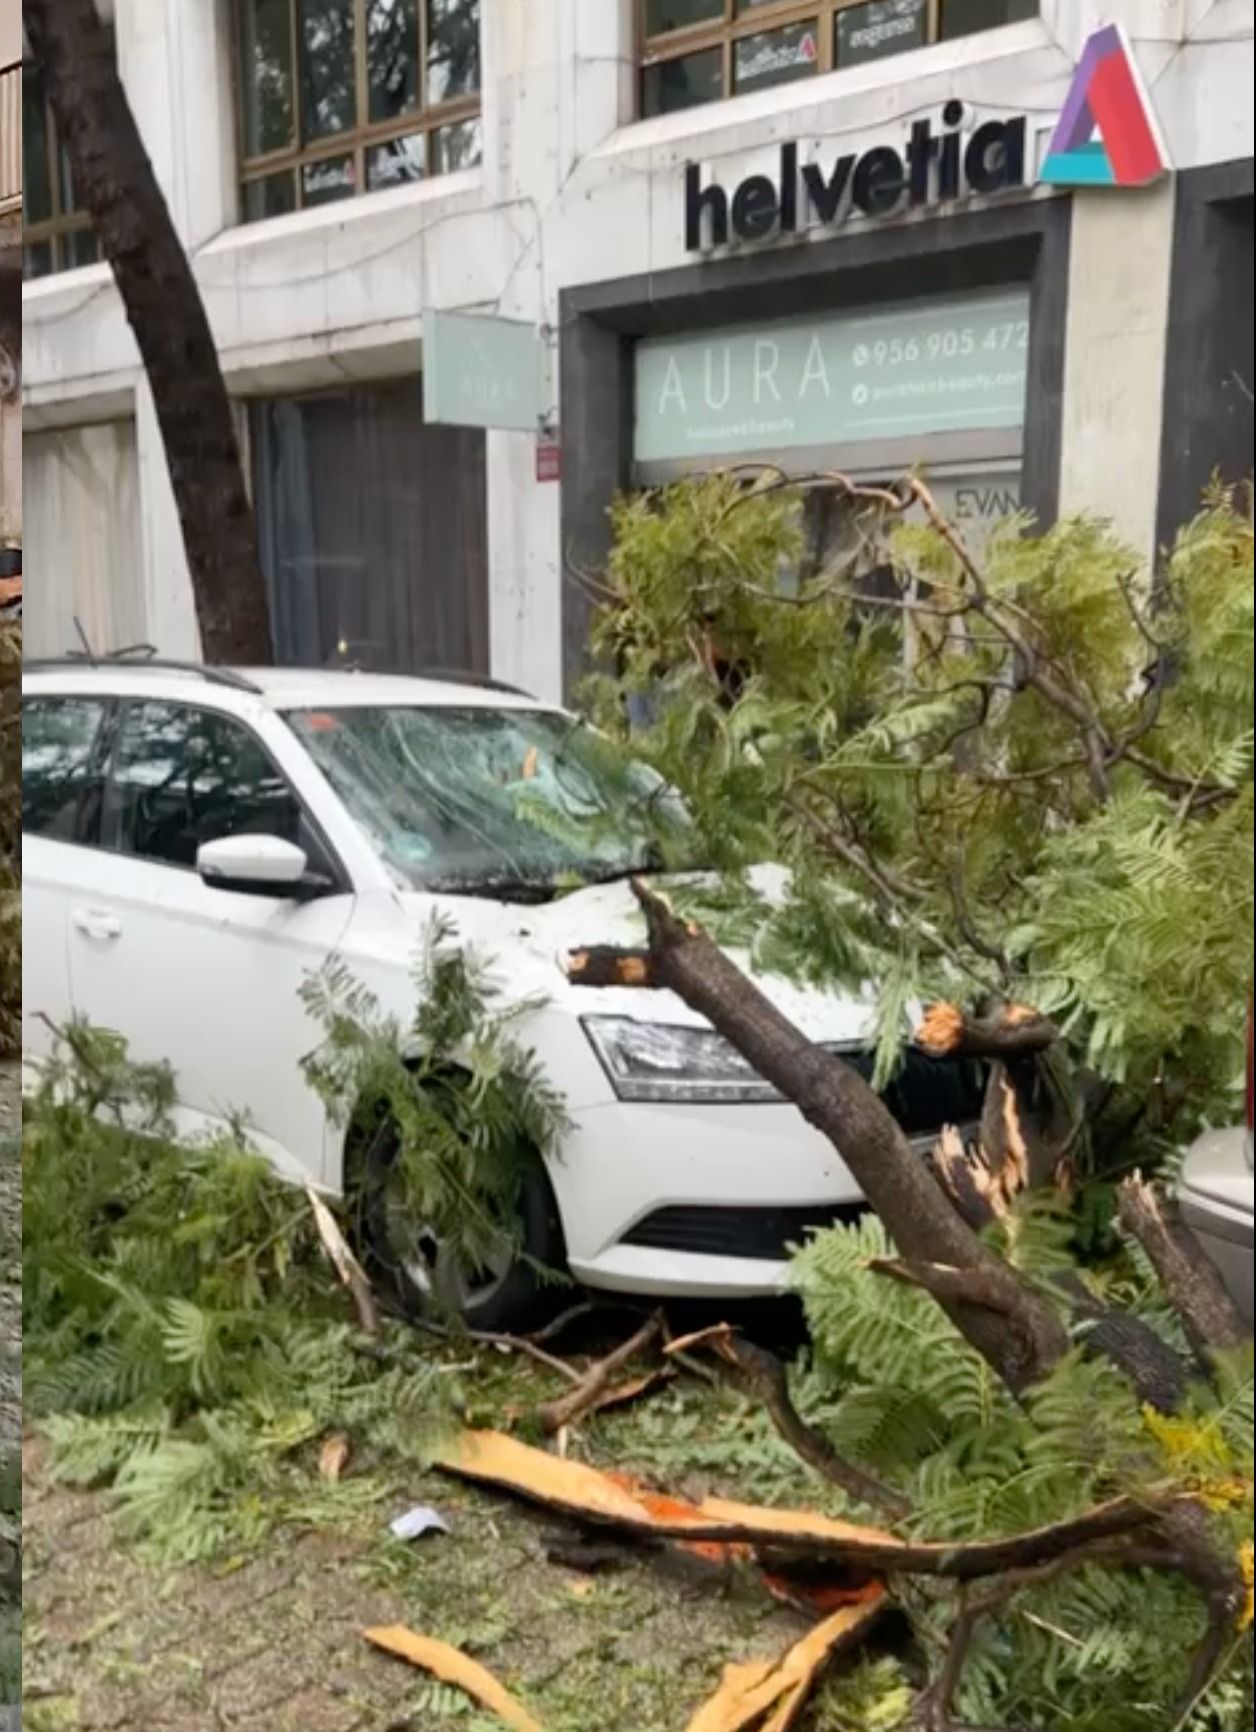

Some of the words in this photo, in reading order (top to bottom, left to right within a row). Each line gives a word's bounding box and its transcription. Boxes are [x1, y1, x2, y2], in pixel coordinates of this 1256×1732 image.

[684, 98, 1027, 252] helvetia
[658, 332, 831, 415] AURA
[873, 338, 920, 366] 956
[926, 328, 975, 361] 905
[982, 321, 1028, 350] 472
